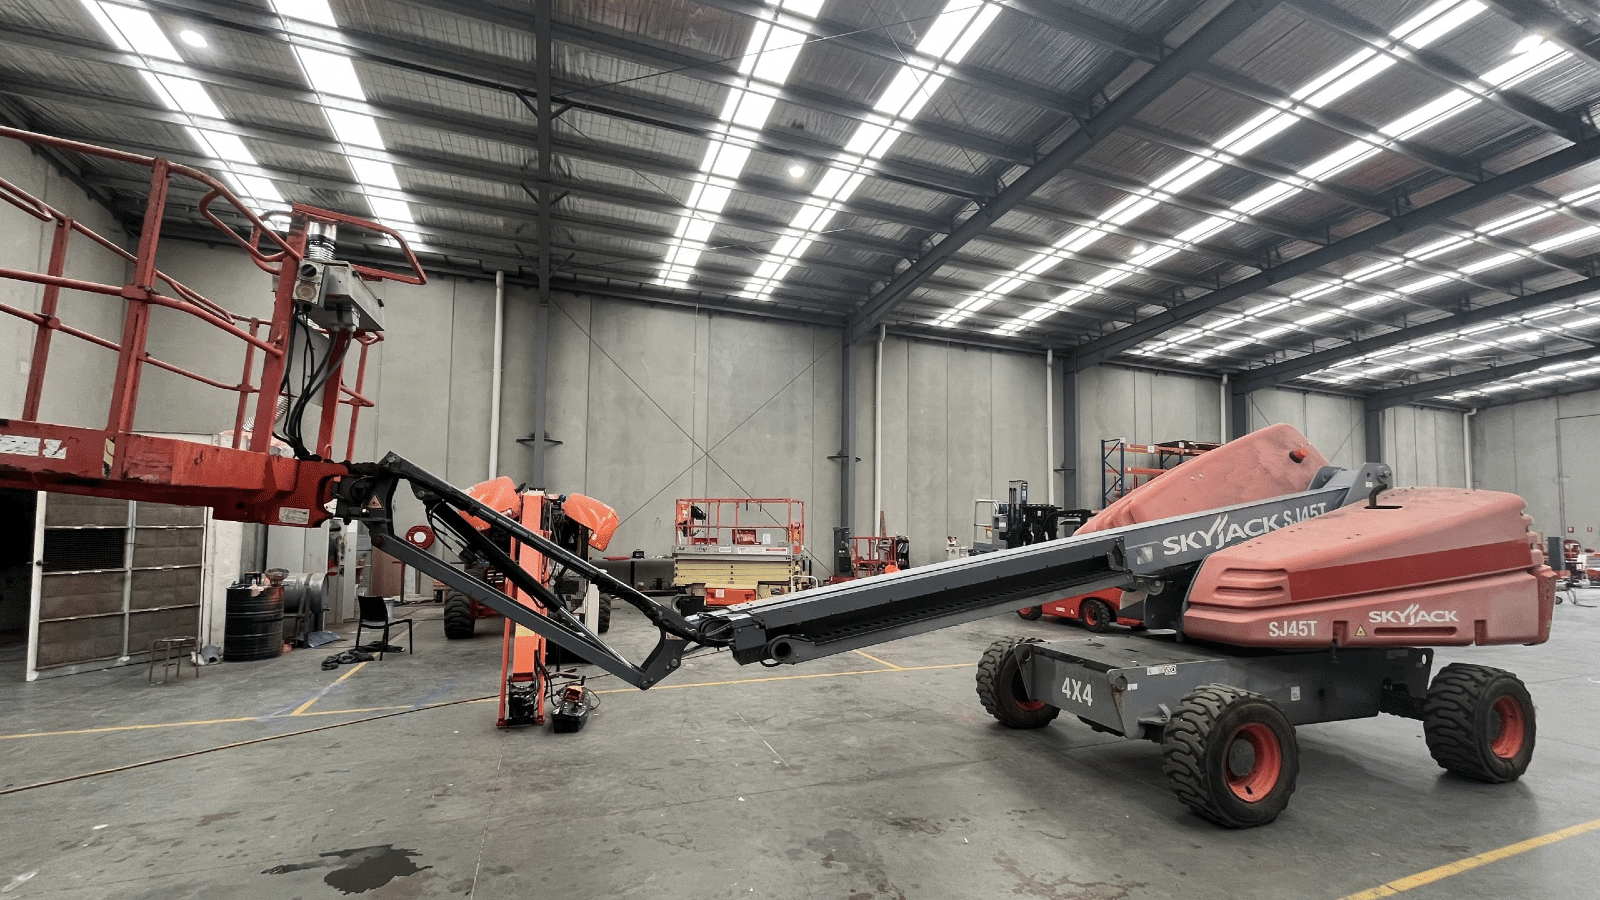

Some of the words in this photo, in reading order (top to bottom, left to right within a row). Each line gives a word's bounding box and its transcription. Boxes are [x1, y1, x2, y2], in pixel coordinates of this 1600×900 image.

[1162, 513, 1284, 556] SKYJACK
[1283, 502, 1327, 528] SJ45T
[1368, 603, 1460, 626] SKYJACK
[1268, 620, 1318, 637] SJ45T
[1061, 677, 1093, 707] 4X4
